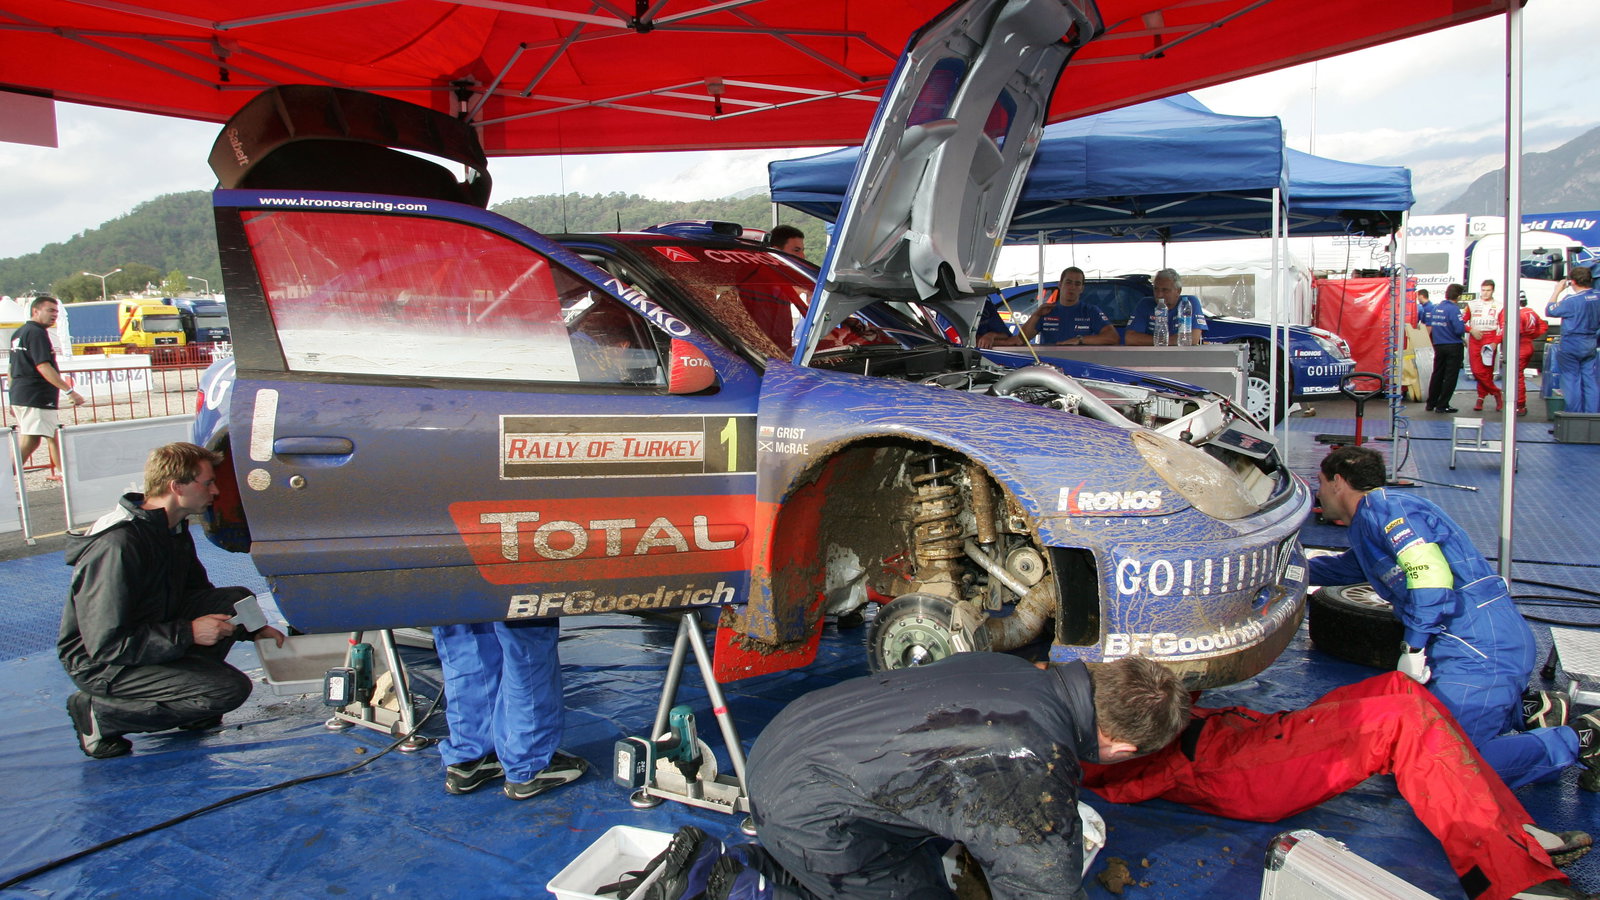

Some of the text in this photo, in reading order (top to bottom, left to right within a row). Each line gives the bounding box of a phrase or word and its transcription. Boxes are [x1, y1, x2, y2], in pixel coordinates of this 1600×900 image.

[259, 196, 428, 212] www.kronosracing.com
[1406, 225, 1455, 237] RONOS
[1473, 222, 1486, 232] C2
[1521, 218, 1597, 231] rld Rally
[603, 278, 692, 337] NIKKO
[776, 426, 806, 440] GRIST
[507, 437, 702, 460] RALLY OF TURKEY
[720, 417, 738, 472] 1
[775, 441, 809, 455] McRAE
[1057, 484, 1162, 513] KRONOS
[1065, 518, 1169, 526] RACING
[479, 510, 737, 562] TOTAL
[505, 581, 737, 620] BFGoodrich
[1104, 618, 1266, 656] BFGoodrich
